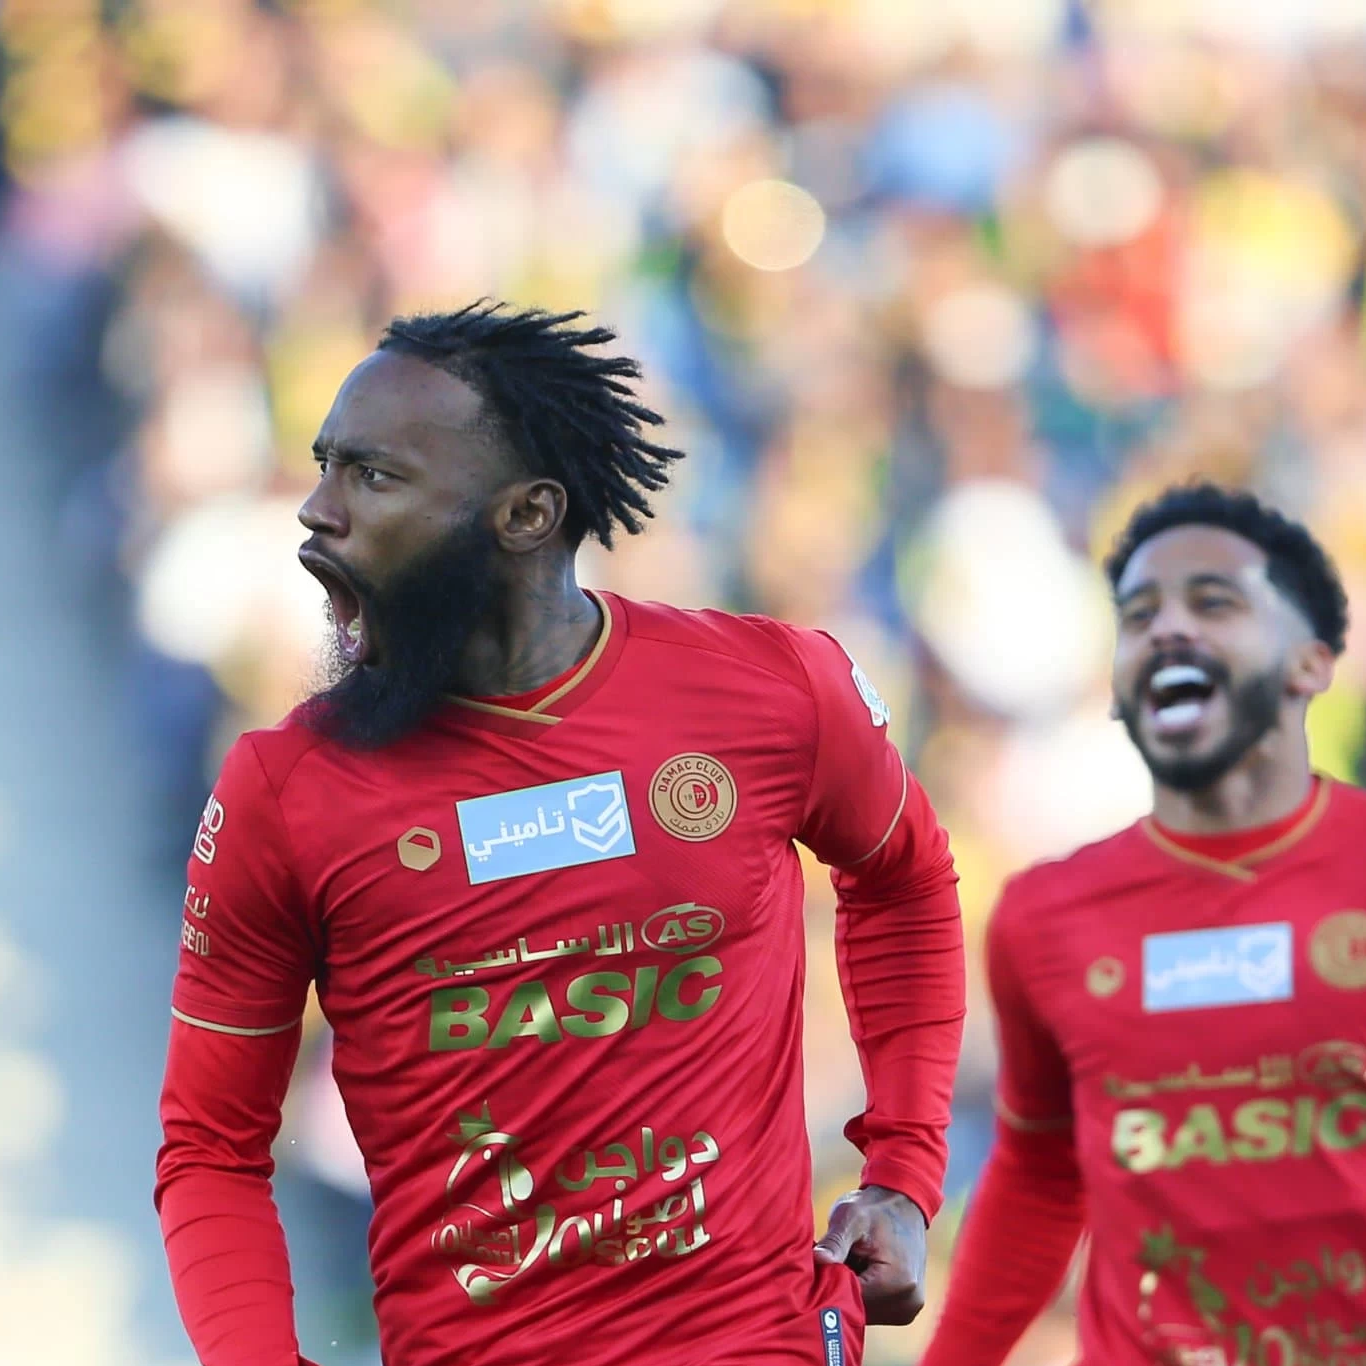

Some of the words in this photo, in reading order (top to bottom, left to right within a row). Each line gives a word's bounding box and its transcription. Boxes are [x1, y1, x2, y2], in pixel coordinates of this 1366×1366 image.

[658, 761, 692, 793] DAMAC
[696, 761, 724, 784] CLUB
[467, 806, 566, 863] تأميني
[657, 914, 713, 944] AS
[429, 956, 723, 1052] BASIC
[555, 1127, 720, 1191] دواجن
